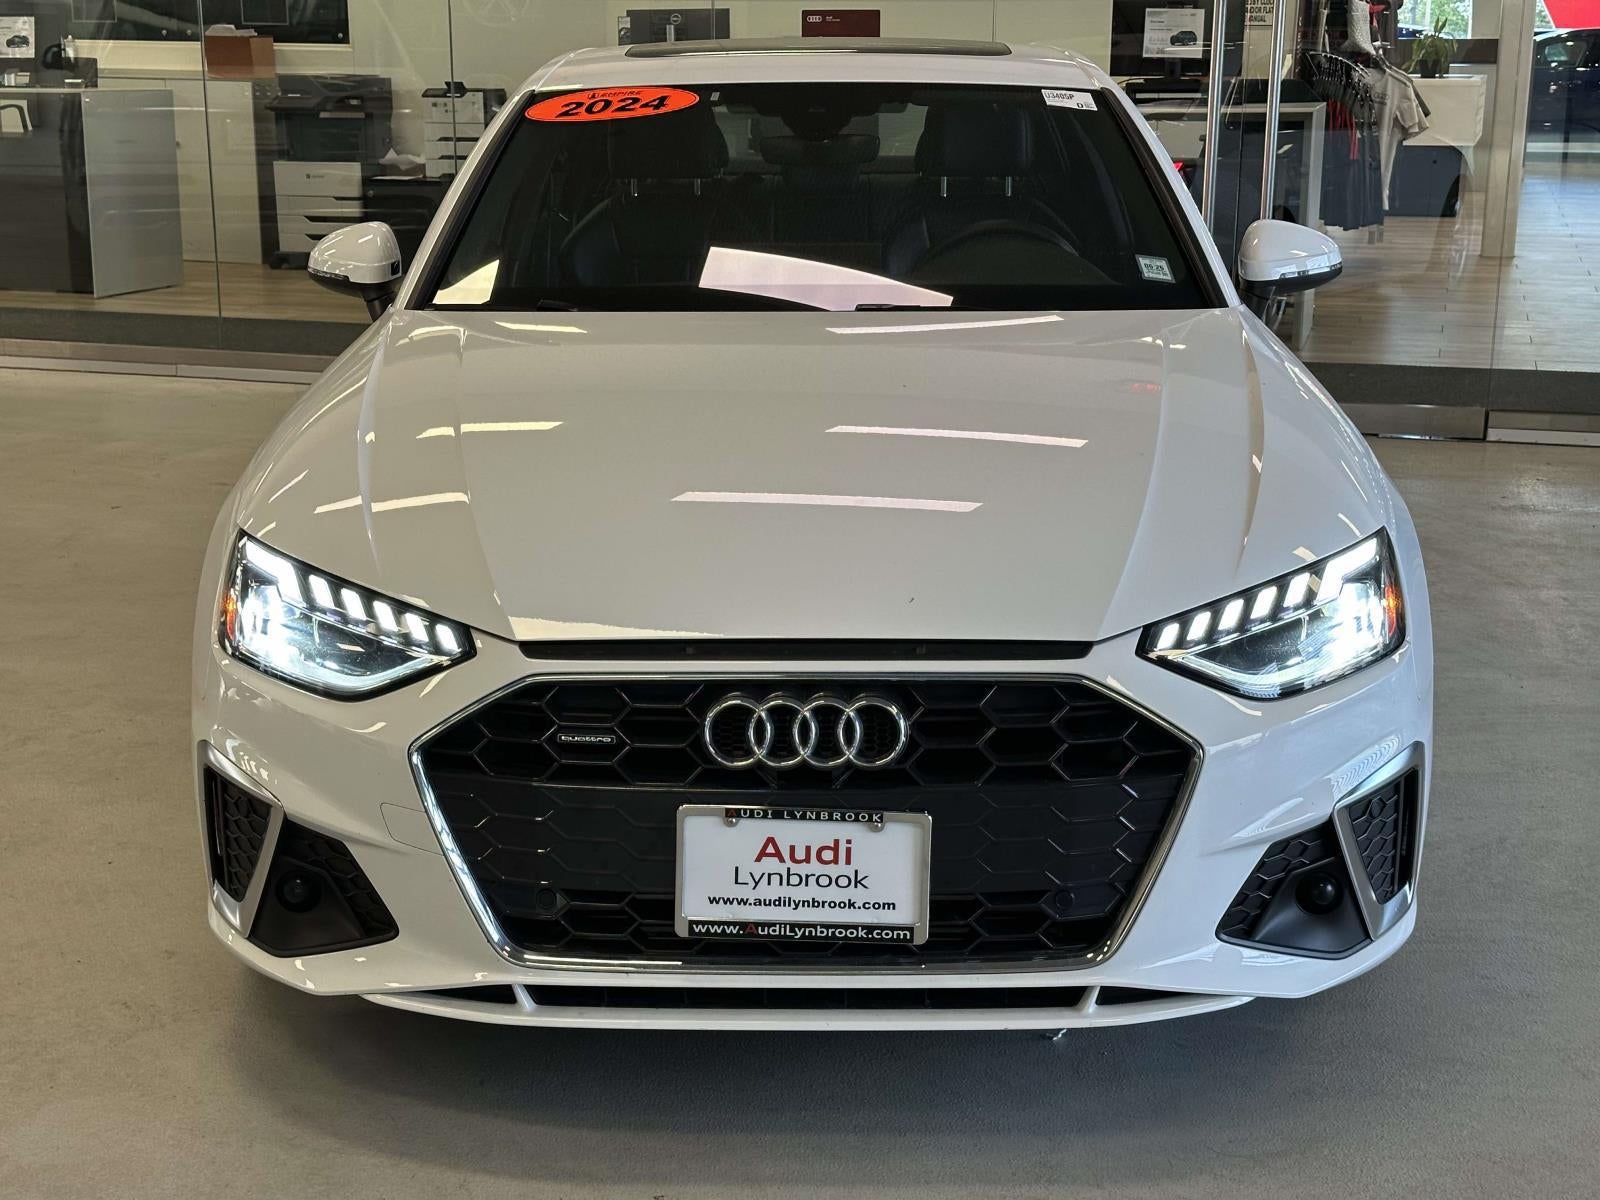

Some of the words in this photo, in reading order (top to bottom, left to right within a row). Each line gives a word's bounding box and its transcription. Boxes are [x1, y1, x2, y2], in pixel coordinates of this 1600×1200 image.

[555, 95, 671, 118] 2024
[728, 809, 772, 818] AUDI
[783, 810, 881, 822] LYNBROOK
[754, 836, 852, 865] Audi
[734, 866, 869, 890] Lynbrook
[708, 895, 896, 911] www.audilynbrook.com
[692, 922, 911, 940] www.AudiLynbrook.com
